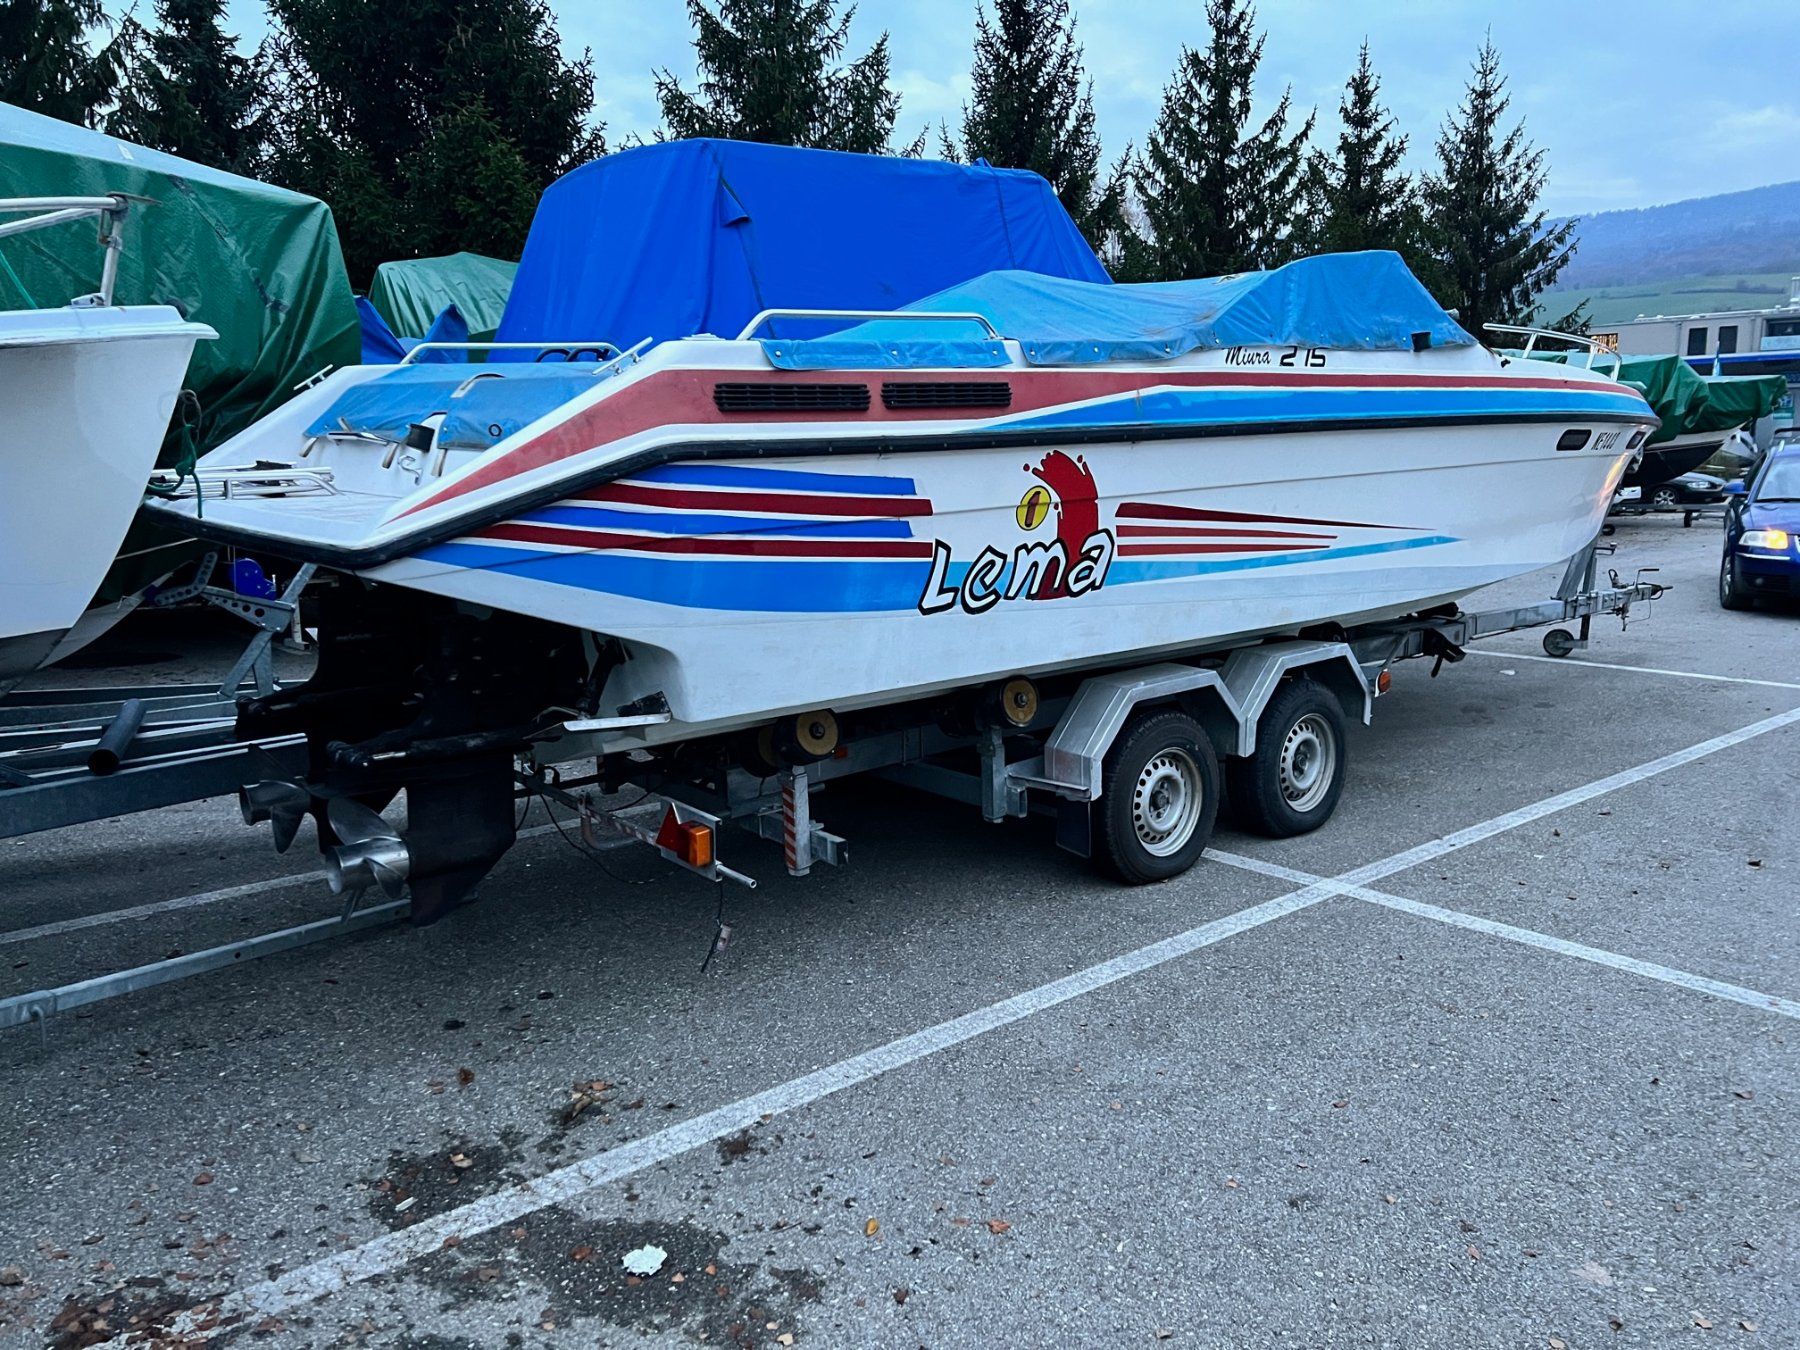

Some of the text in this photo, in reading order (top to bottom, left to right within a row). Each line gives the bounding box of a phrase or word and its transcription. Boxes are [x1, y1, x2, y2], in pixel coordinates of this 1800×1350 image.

[1225, 345, 1327, 368] Miura 215
[917, 528, 1115, 616] Lema
